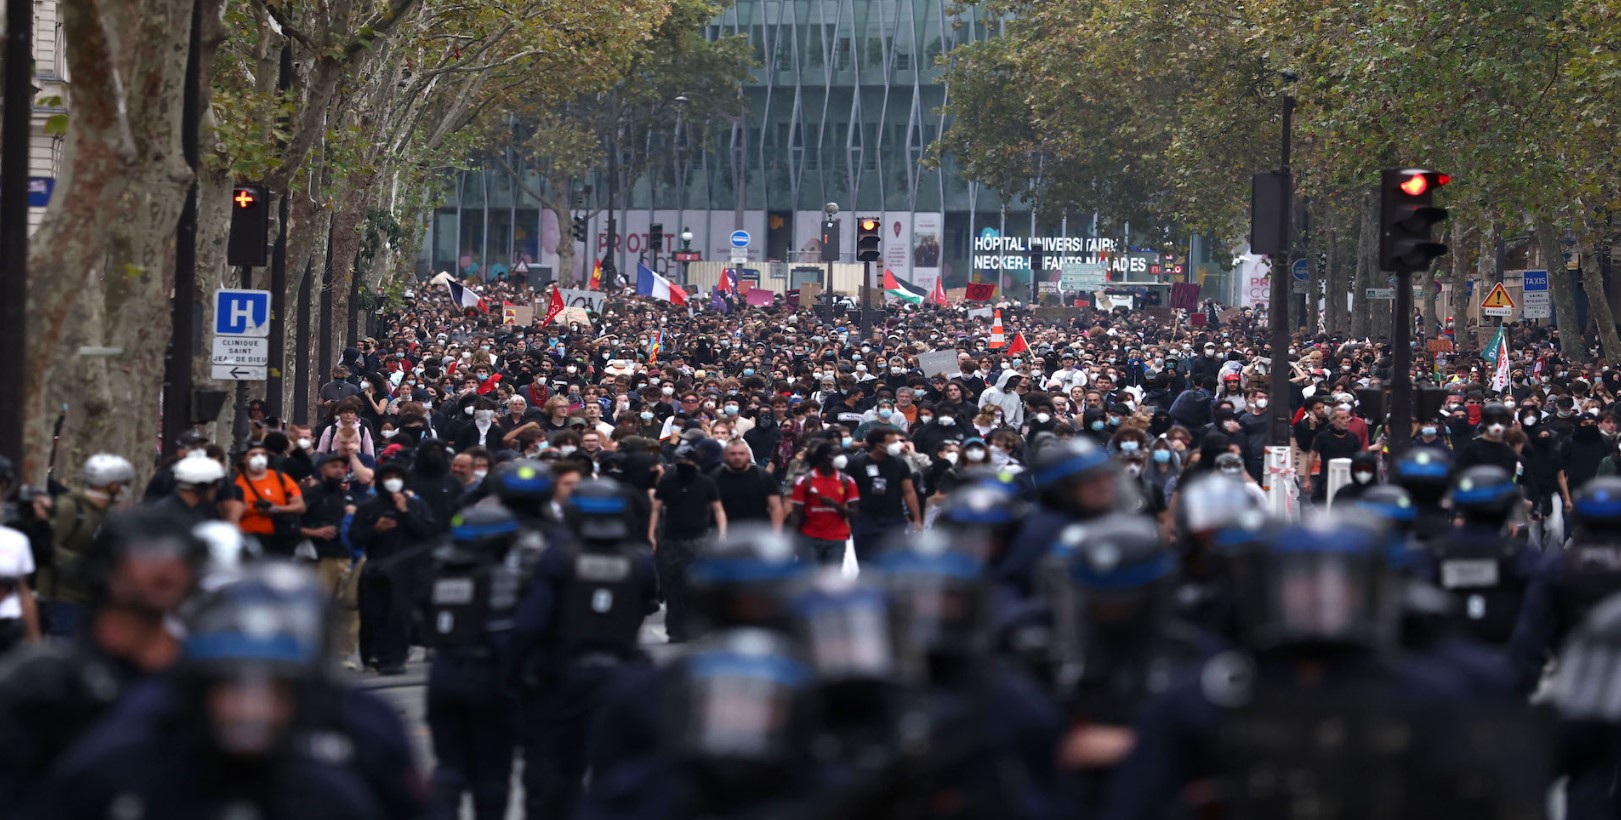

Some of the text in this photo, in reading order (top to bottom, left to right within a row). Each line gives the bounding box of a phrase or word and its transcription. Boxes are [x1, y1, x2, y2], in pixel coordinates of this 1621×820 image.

[598, 233, 676, 253] PROJT
[975, 233, 1025, 251] HÔPITAL
[1525, 277, 1547, 285] TAXIS
[230, 299, 254, 328] H
